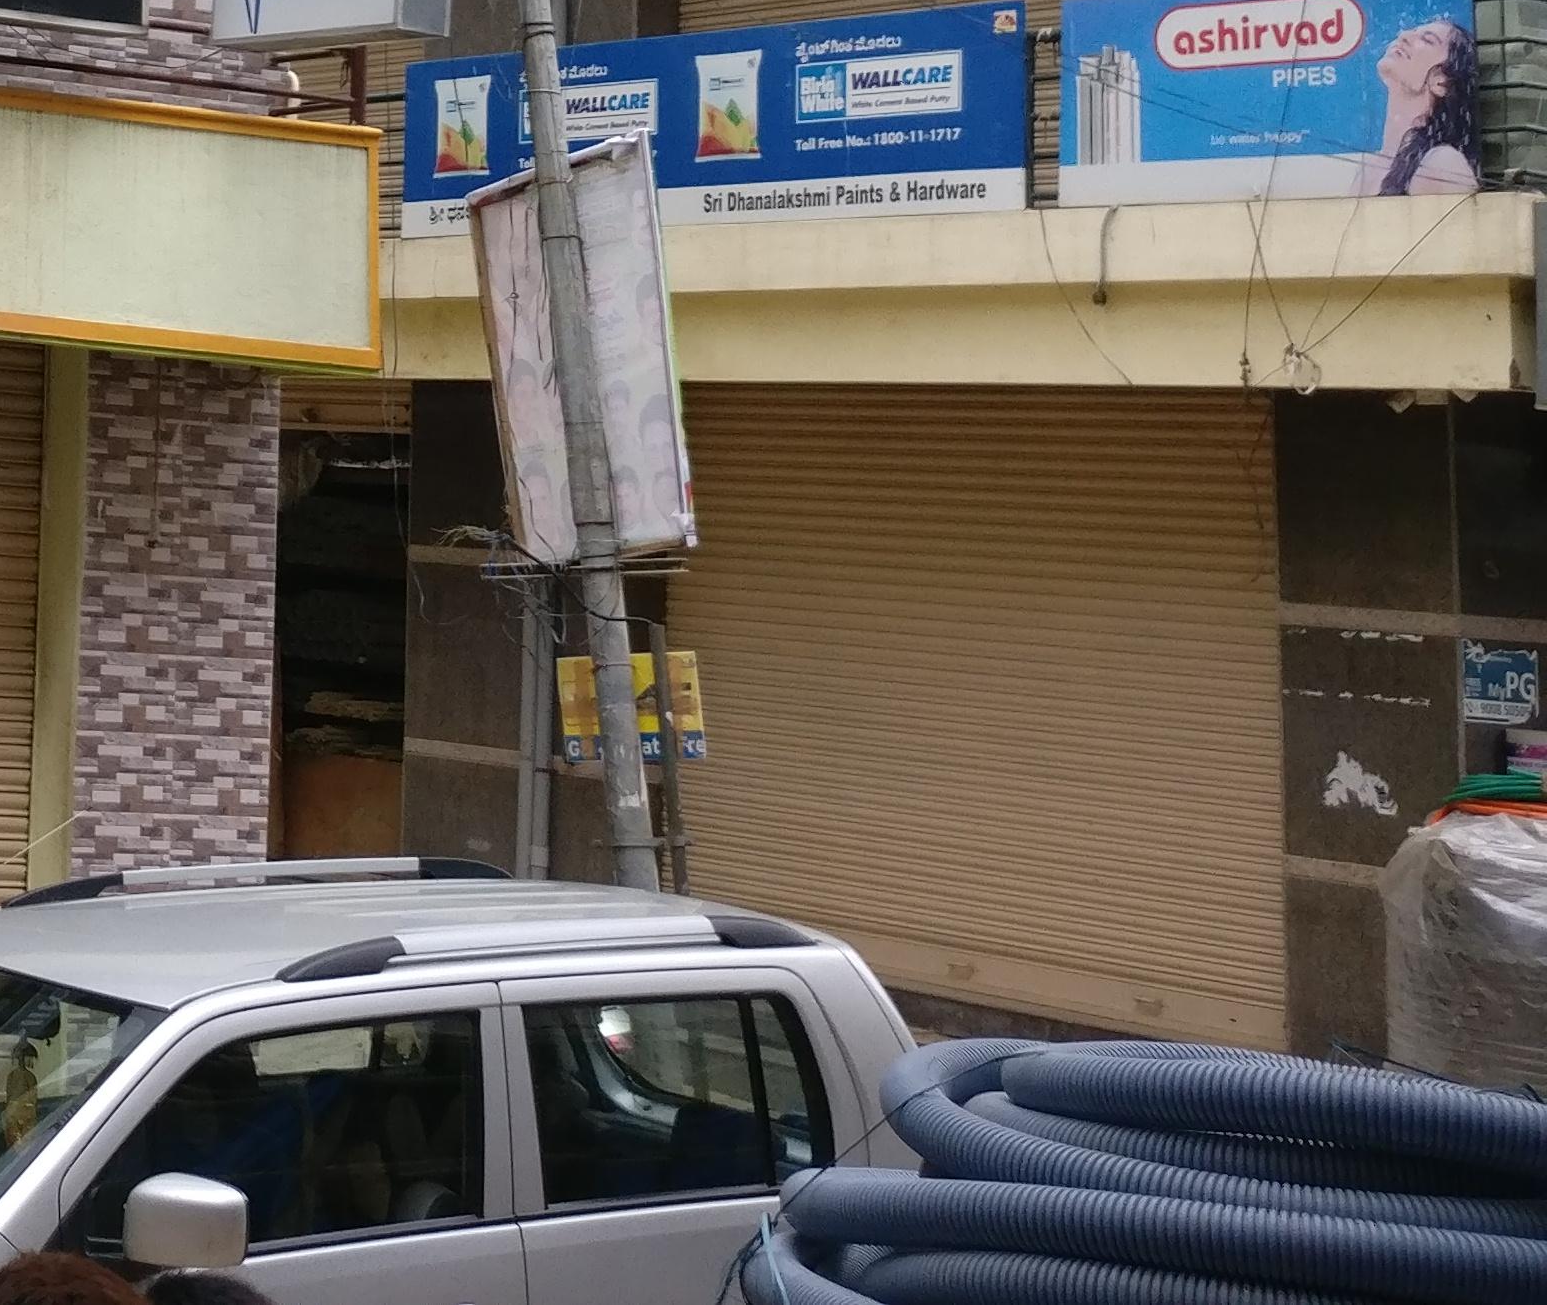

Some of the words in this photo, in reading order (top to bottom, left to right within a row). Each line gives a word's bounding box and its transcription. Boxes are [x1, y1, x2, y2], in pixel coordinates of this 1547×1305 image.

[1172, 7, 1345, 56] ashirvad
[851, 64, 953, 91] WALLCARE
[1271, 65, 1338, 89] PIPES
[566, 92, 651, 115] WALLCARE
[817, 137, 844, 150] Free
[873, 127, 963, 146] 1800-11-1717
[703, 192, 726, 214] Sri
[728, 183, 831, 212] Dhanalakshmi
[835, 183, 883, 207] Paints
[889, 182, 901, 203] &
[906, 179, 987, 202] Hardware
